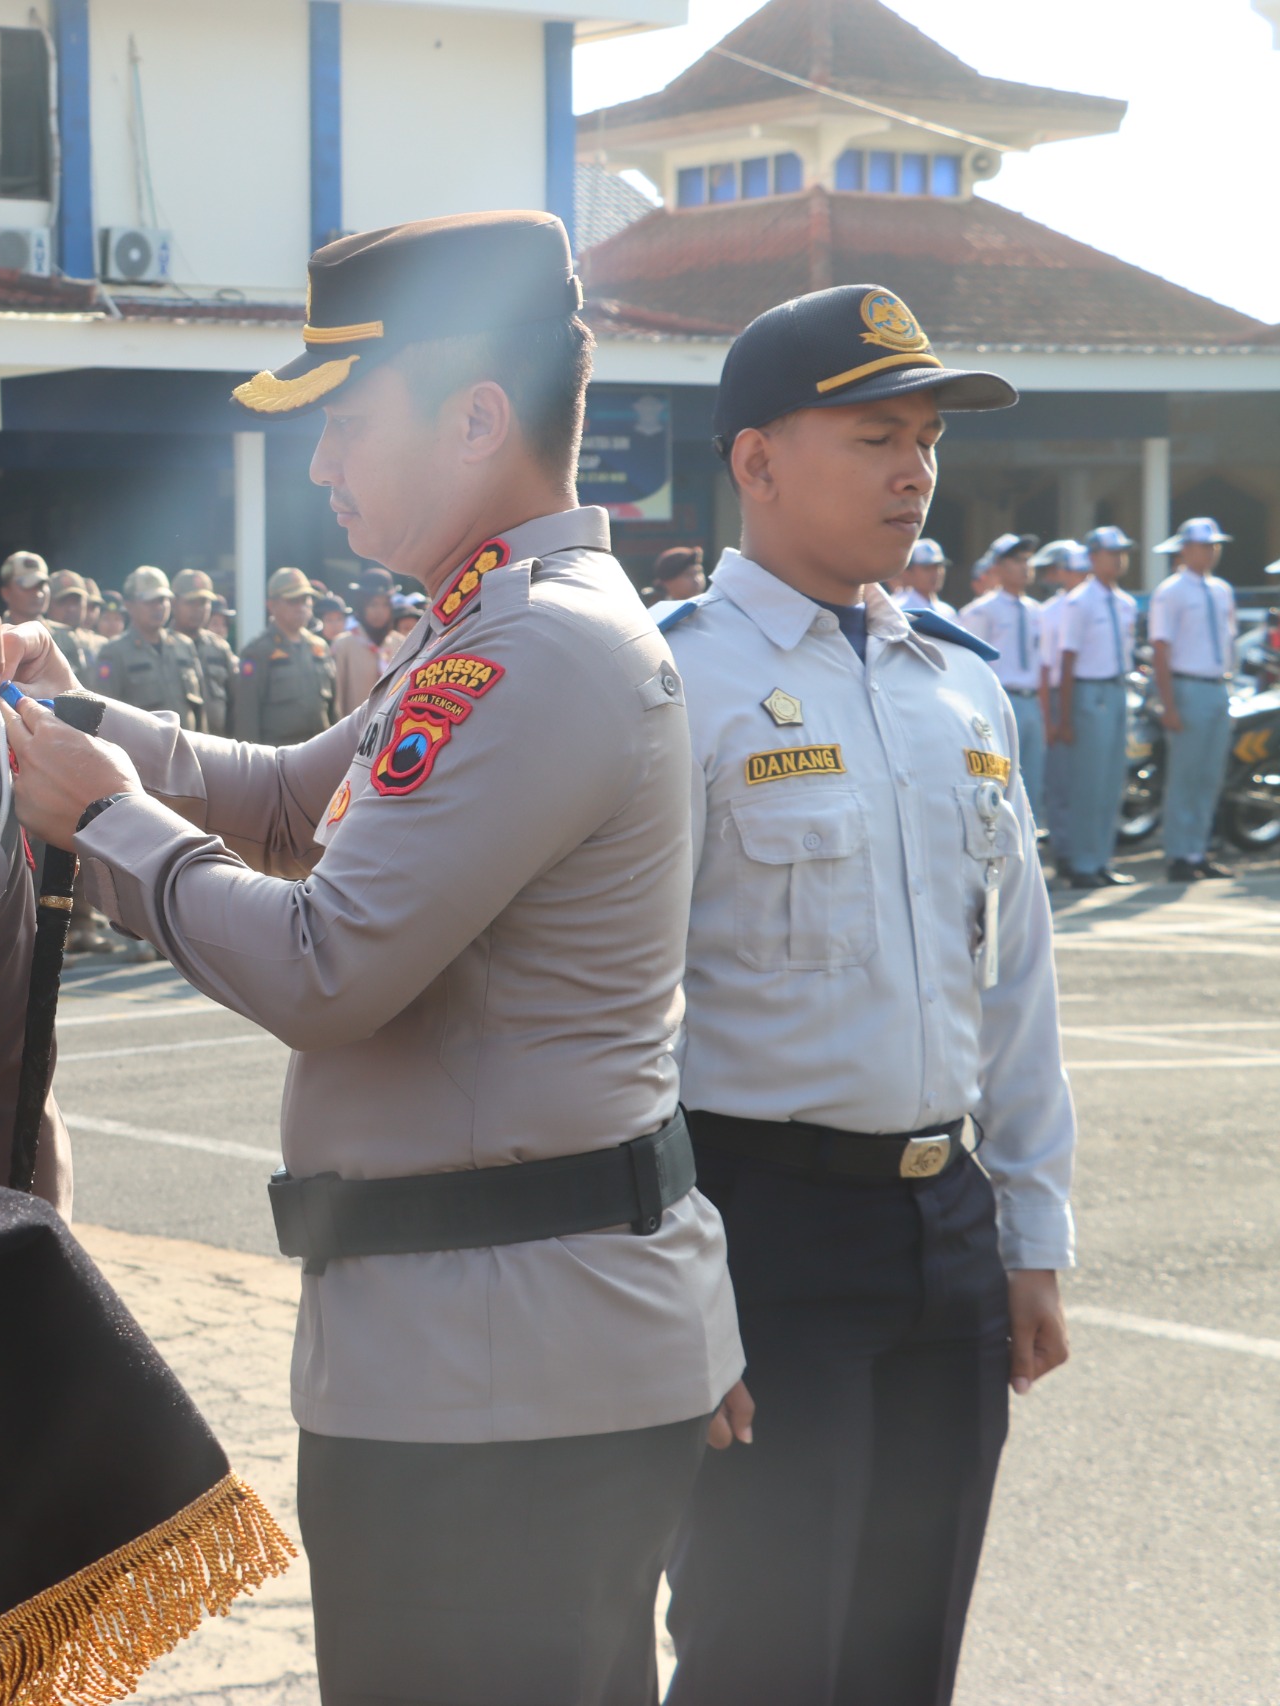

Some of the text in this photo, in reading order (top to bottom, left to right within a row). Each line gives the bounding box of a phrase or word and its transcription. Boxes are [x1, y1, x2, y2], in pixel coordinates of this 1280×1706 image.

[416, 658, 492, 685] POLRESTA
[419, 672, 479, 688] CILACAP
[408, 694, 464, 716] JAWA TENGAH
[752, 749, 836, 779] DANANG
